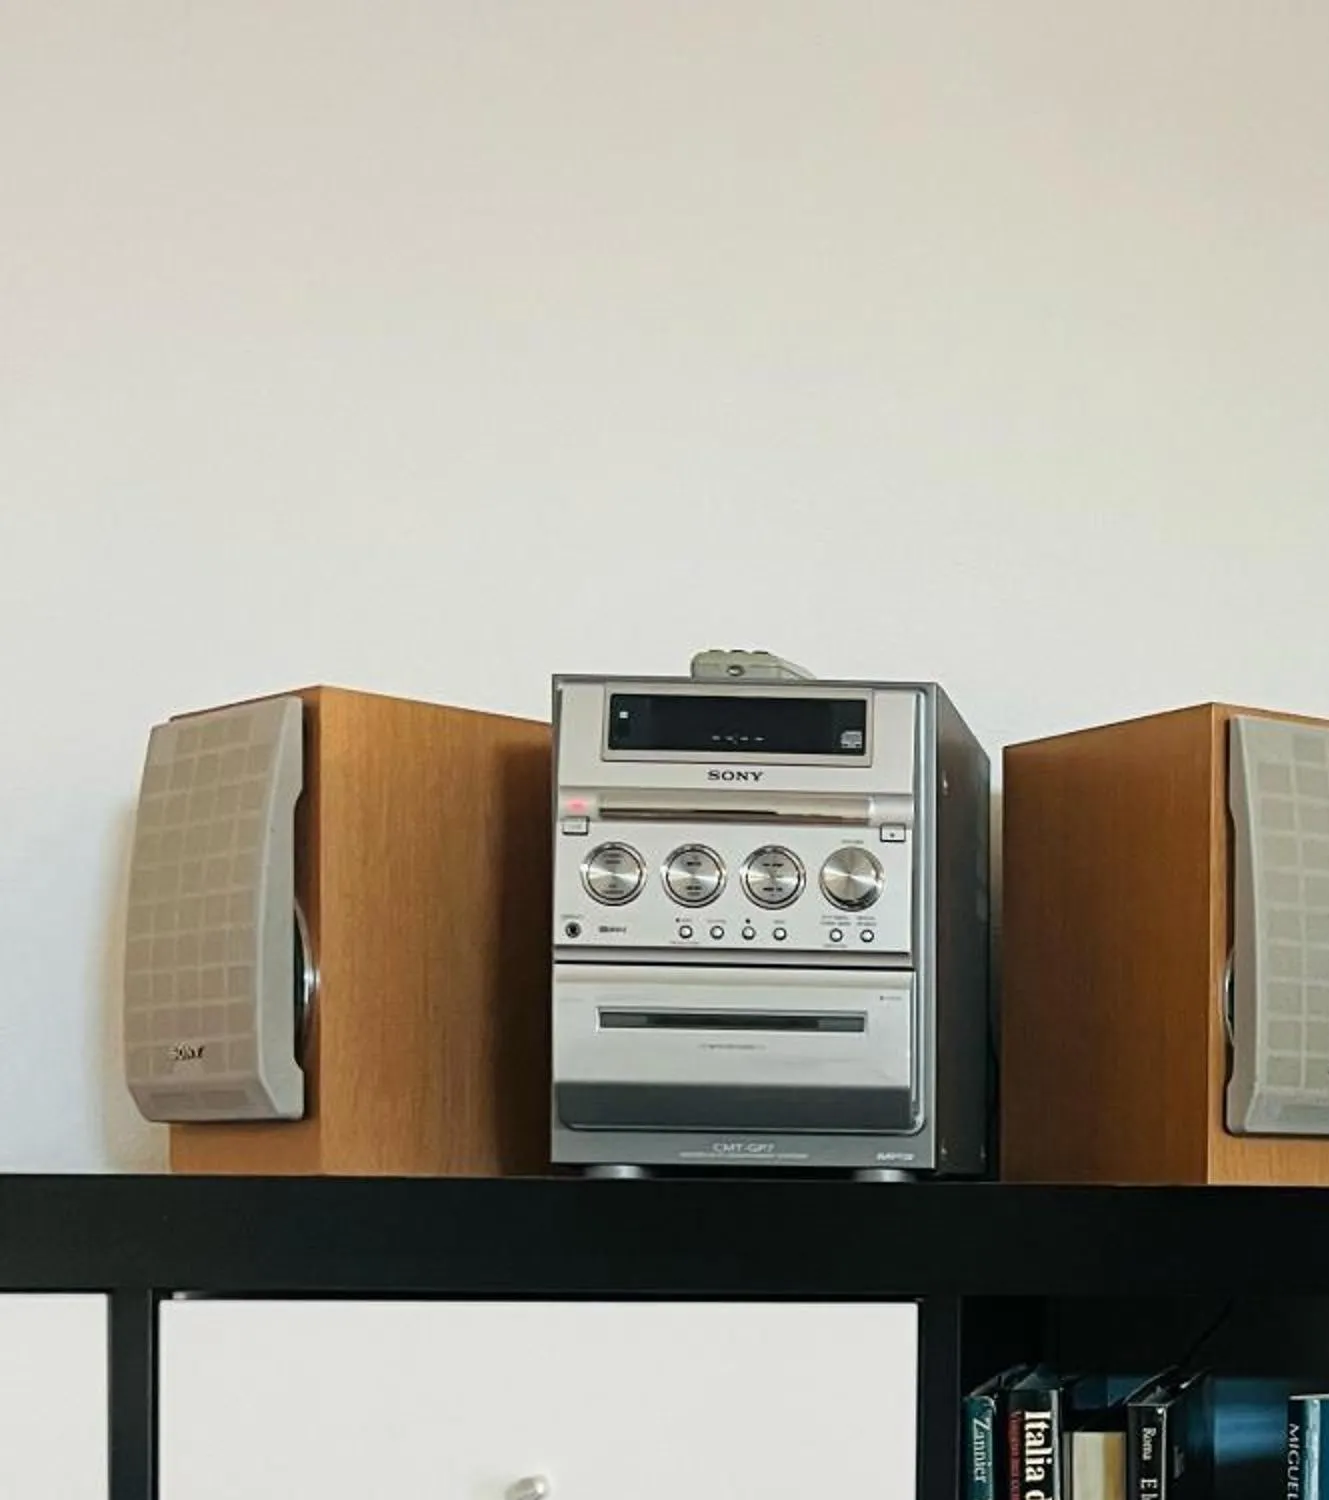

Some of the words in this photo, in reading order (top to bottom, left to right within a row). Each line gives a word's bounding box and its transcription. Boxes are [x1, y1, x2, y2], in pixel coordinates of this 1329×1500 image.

[707, 770, 764, 782] SONY
[973, 1417, 992, 1484] Zannier
[1024, 1411, 1052, 1482] Italia
[1141, 1426, 1156, 1461] Roma
[1140, 1477, 1158, 1490] E
